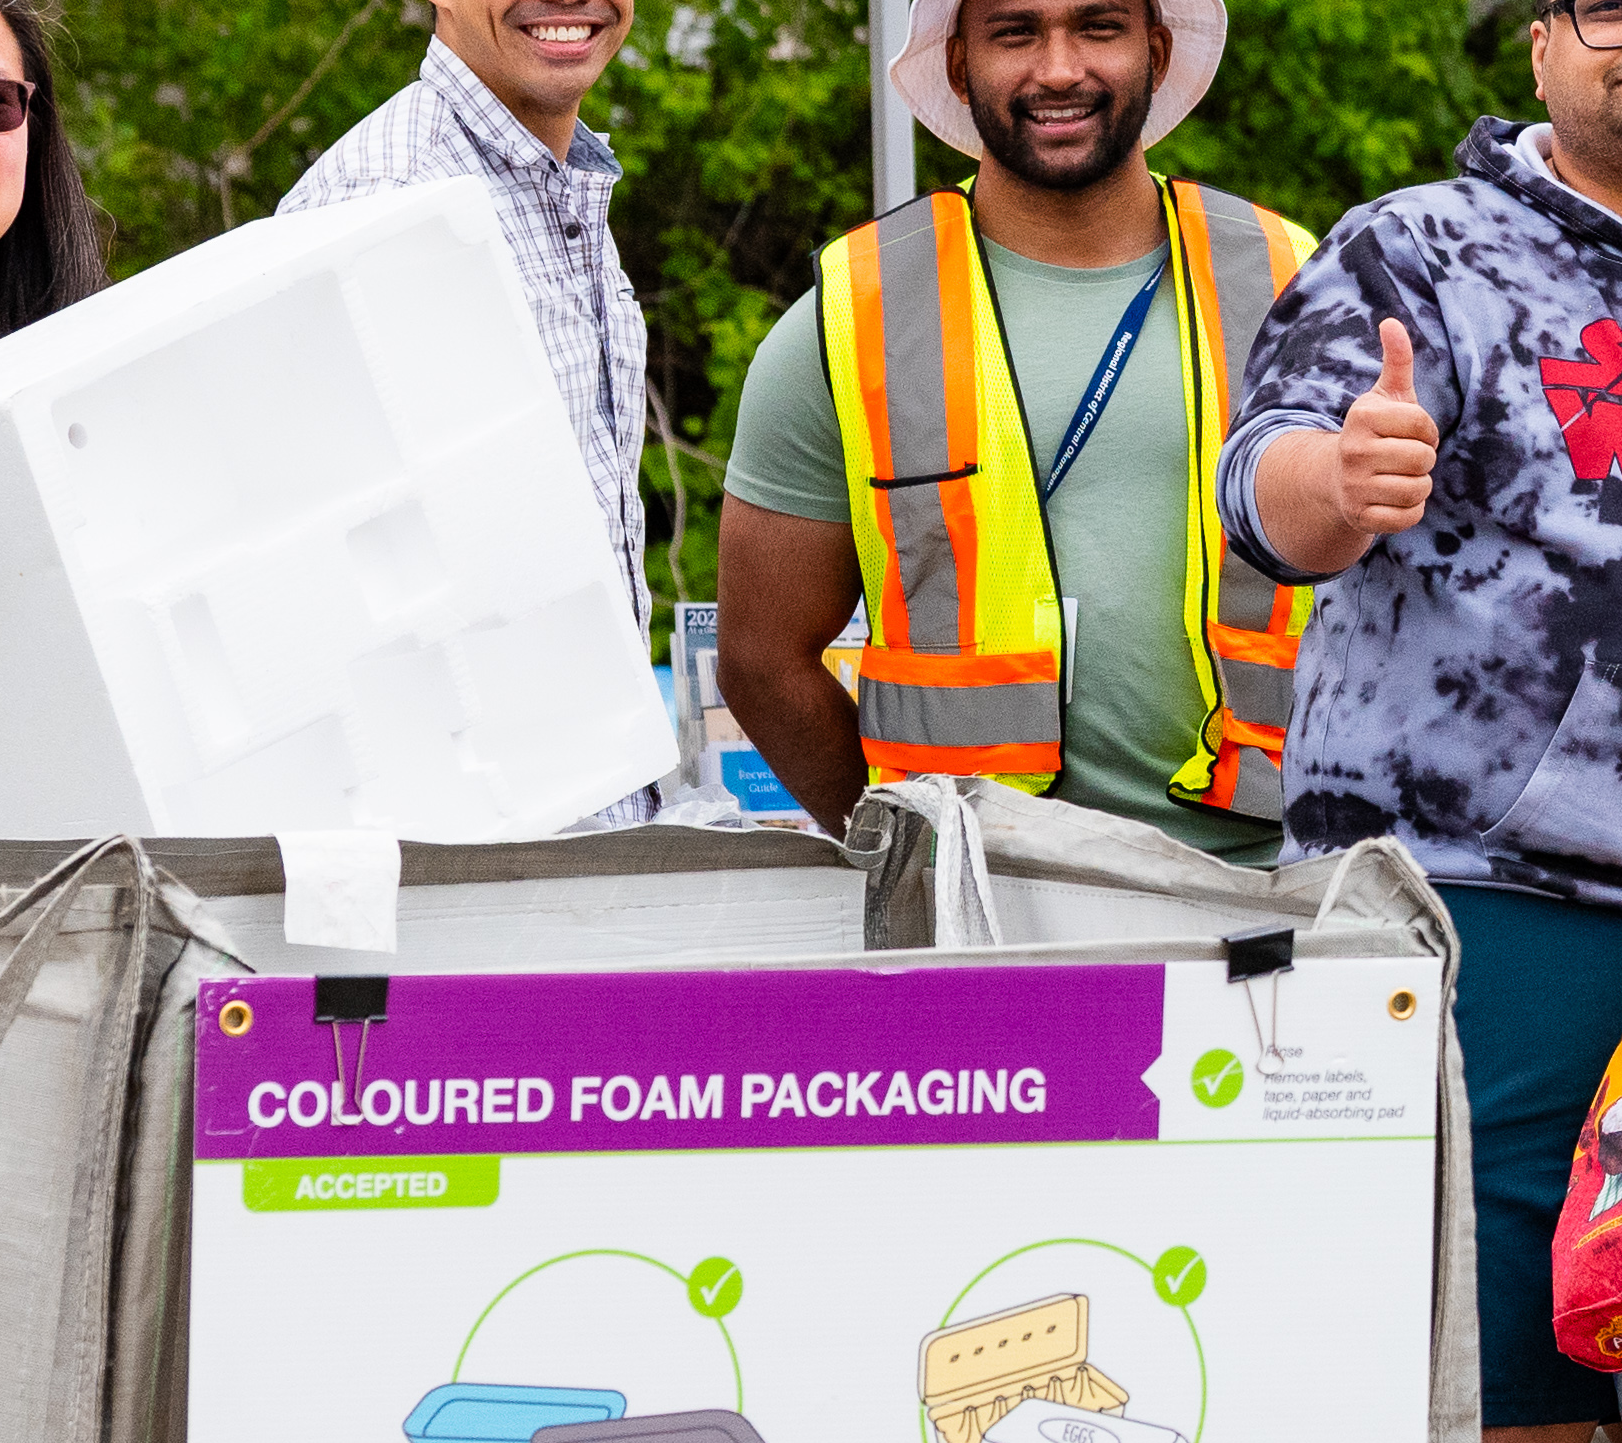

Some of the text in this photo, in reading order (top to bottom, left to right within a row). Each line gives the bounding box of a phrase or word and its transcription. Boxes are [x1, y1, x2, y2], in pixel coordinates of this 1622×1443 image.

[1108, 331, 1132, 371] Regional
[1093, 368, 1114, 402] District
[1087, 399, 1099, 414] of
[1071, 412, 1093, 447] Central
[748, 783, 778, 793] Guide
[1266, 1045, 1303, 1057] Rnse
[1264, 1074, 1320, 1083] Remove
[247, 1067, 1048, 1130] COLOURED FOAM PACKAGING
[1264, 1088, 1372, 1106] tape, paper and
[1263, 1105, 1406, 1122] liquid-absorbing pad
[294, 1169, 448, 1202] ACCEPTED
